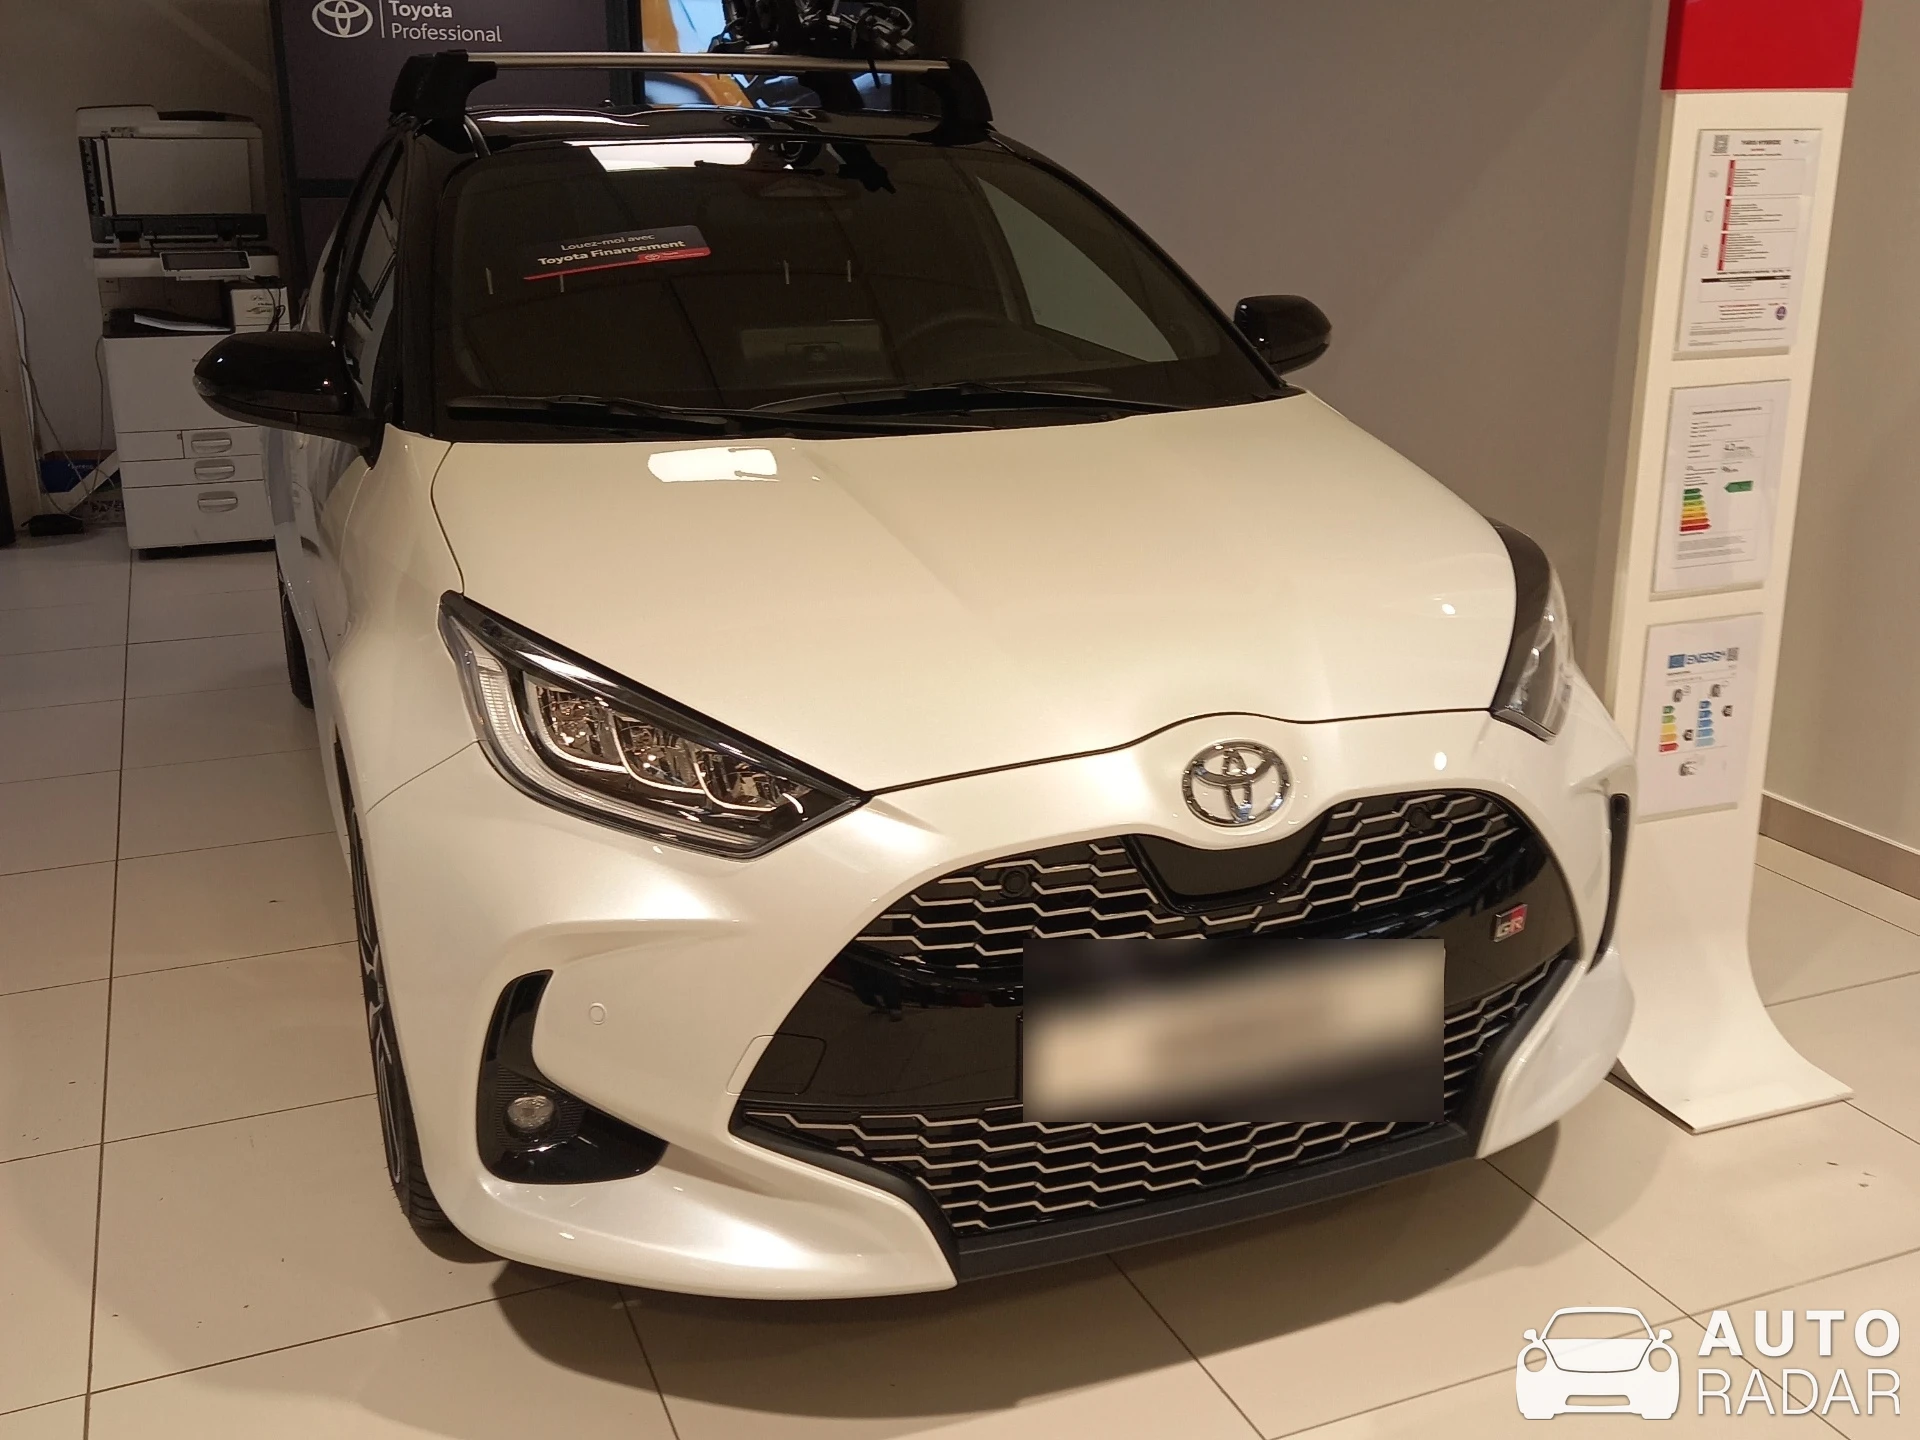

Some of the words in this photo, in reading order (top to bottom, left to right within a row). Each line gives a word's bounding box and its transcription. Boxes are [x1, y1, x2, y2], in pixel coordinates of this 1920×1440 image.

[388, 0, 453, 21] Toyota
[391, 22, 503, 43] Professional
[561, 236, 626, 251] Louez-moi
[629, 233, 656, 243] avec
[538, 252, 589, 266] Toyota
[591, 240, 687, 259] Financement
[1497, 916, 1523, 938] GR
